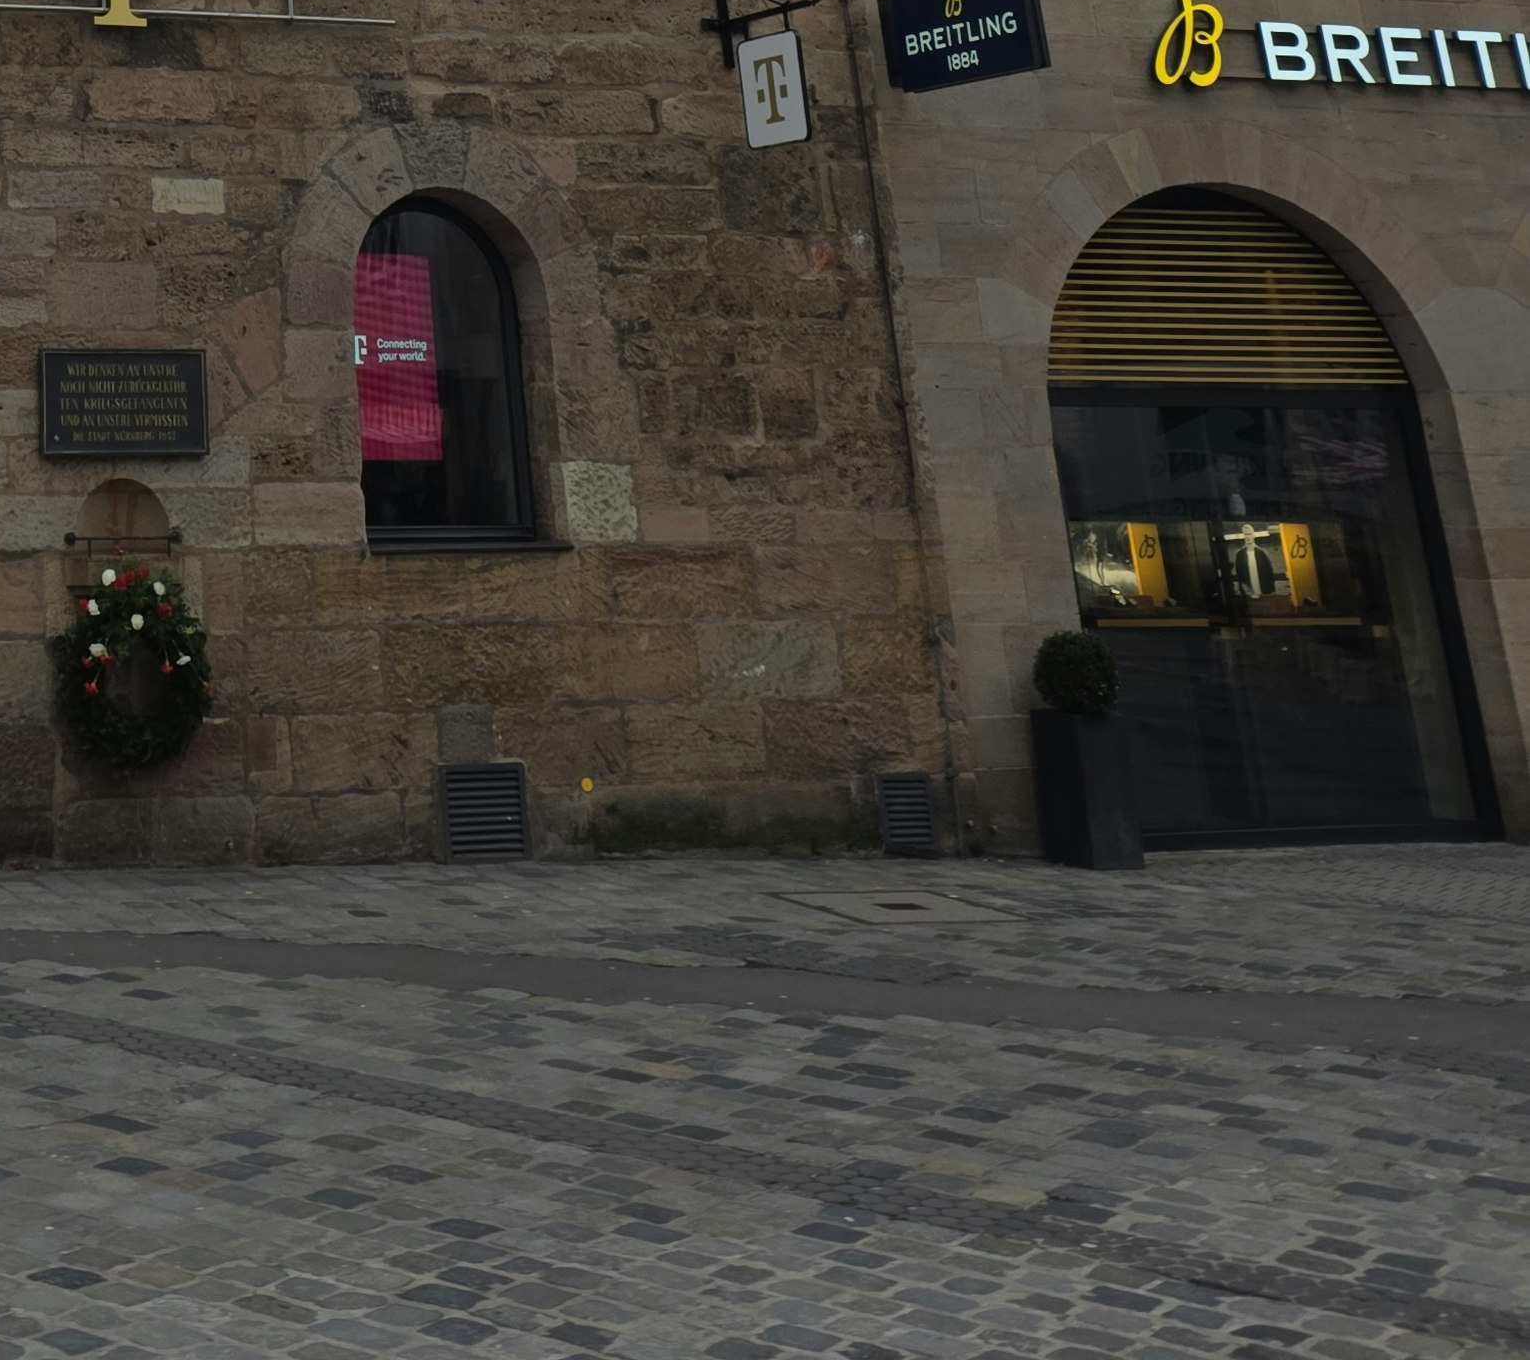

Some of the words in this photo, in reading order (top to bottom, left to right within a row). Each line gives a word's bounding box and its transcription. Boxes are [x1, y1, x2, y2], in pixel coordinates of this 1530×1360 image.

[905, 11, 1018, 56] BREITLING
[947, 50, 980, 71] 1884
[753, 54, 788, 124] T
[377, 338, 427, 351] Connecting
[378, 352, 397, 363] your
[399, 351, 426, 361] world.
[67, 363, 86, 376] WIR
[88, 363, 124, 376] DENKEN
[126, 363, 140, 376] AN
[143, 363, 178, 376] UNSERE
[60, 380, 85, 394] NOCH
[89, 380, 115, 394] NICHT
[60, 397, 79, 410] TEN
[84, 397, 188, 410] KRIEGSGEFANGENEN
[61, 415, 80, 427] UND
[83, 414, 95, 426] AN
[97, 414, 131, 427] UNSERE
[134, 414, 189, 427] VERMISSTEN
[87, 431, 111, 441] STADT
